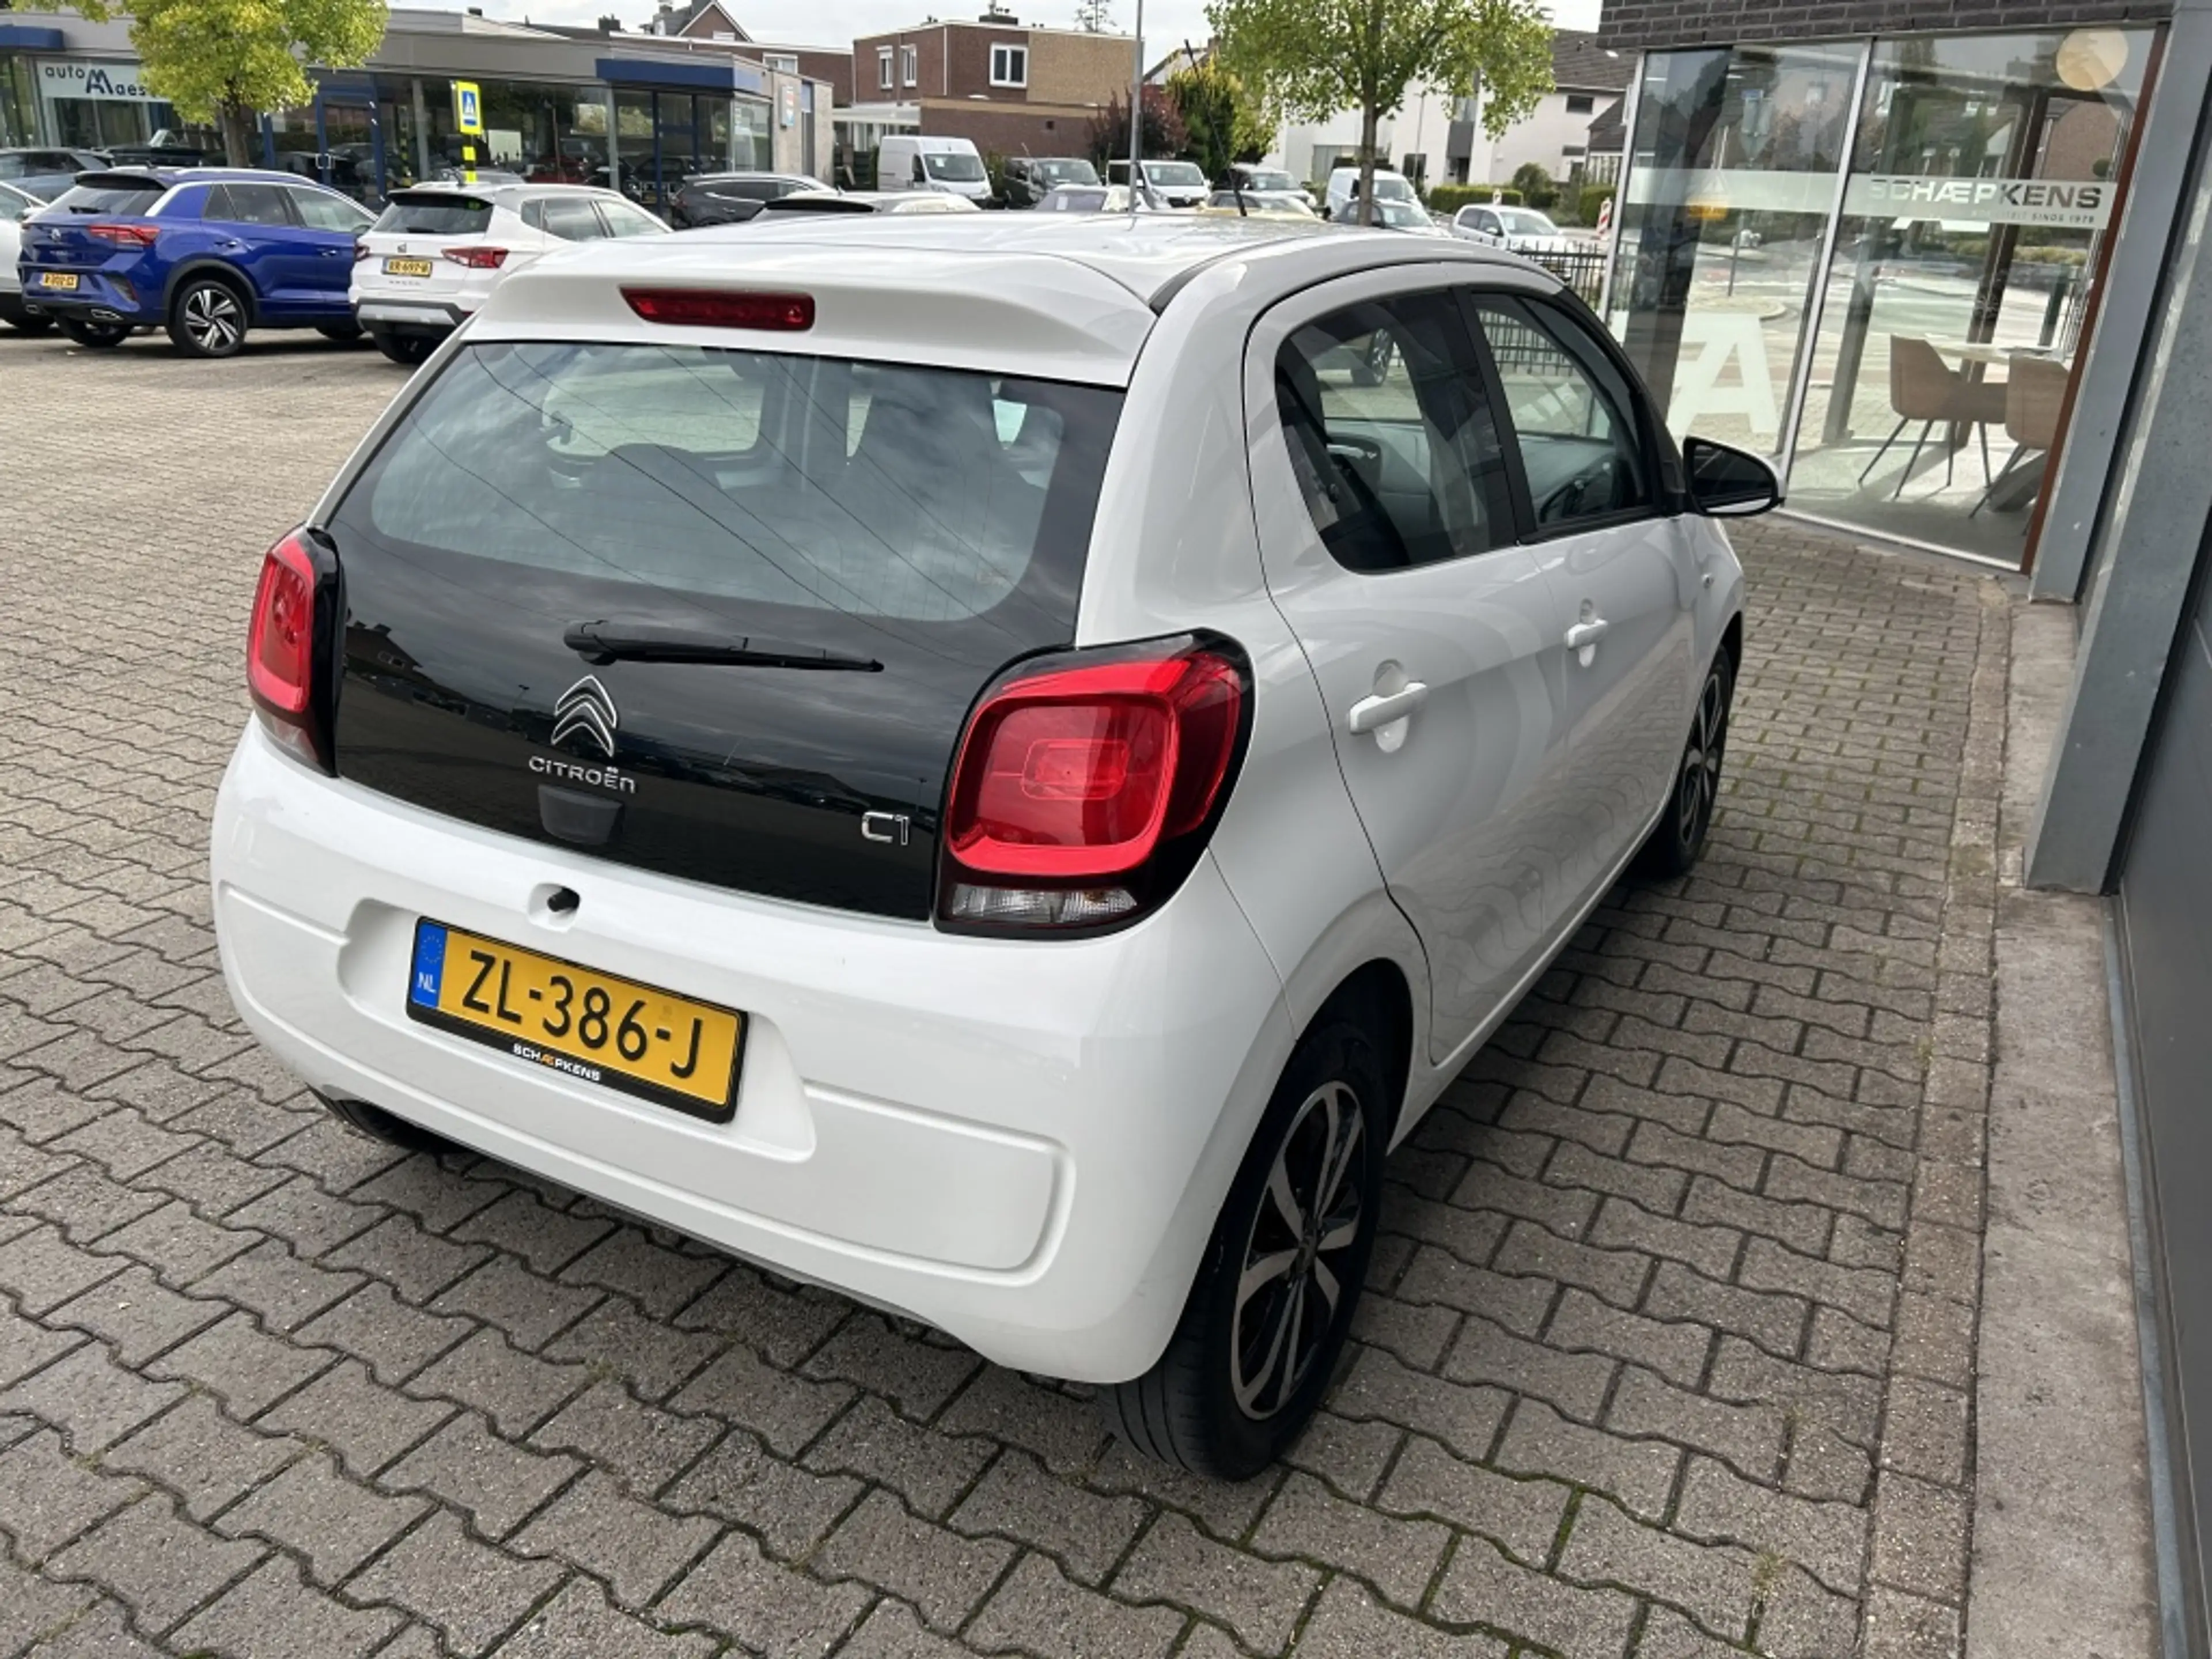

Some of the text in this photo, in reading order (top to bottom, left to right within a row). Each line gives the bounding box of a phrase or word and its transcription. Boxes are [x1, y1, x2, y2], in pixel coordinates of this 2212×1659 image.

[45, 65, 85, 79] auto
[1870, 179, 2101, 209] SCHÆPKENS
[528, 755, 635, 794] CITROËN
[861, 810, 909, 846] C1
[417, 971, 437, 994] NL
[461, 949, 703, 1079] ZL-386-J
[513, 1043, 600, 1081] SCHÆPKENS
